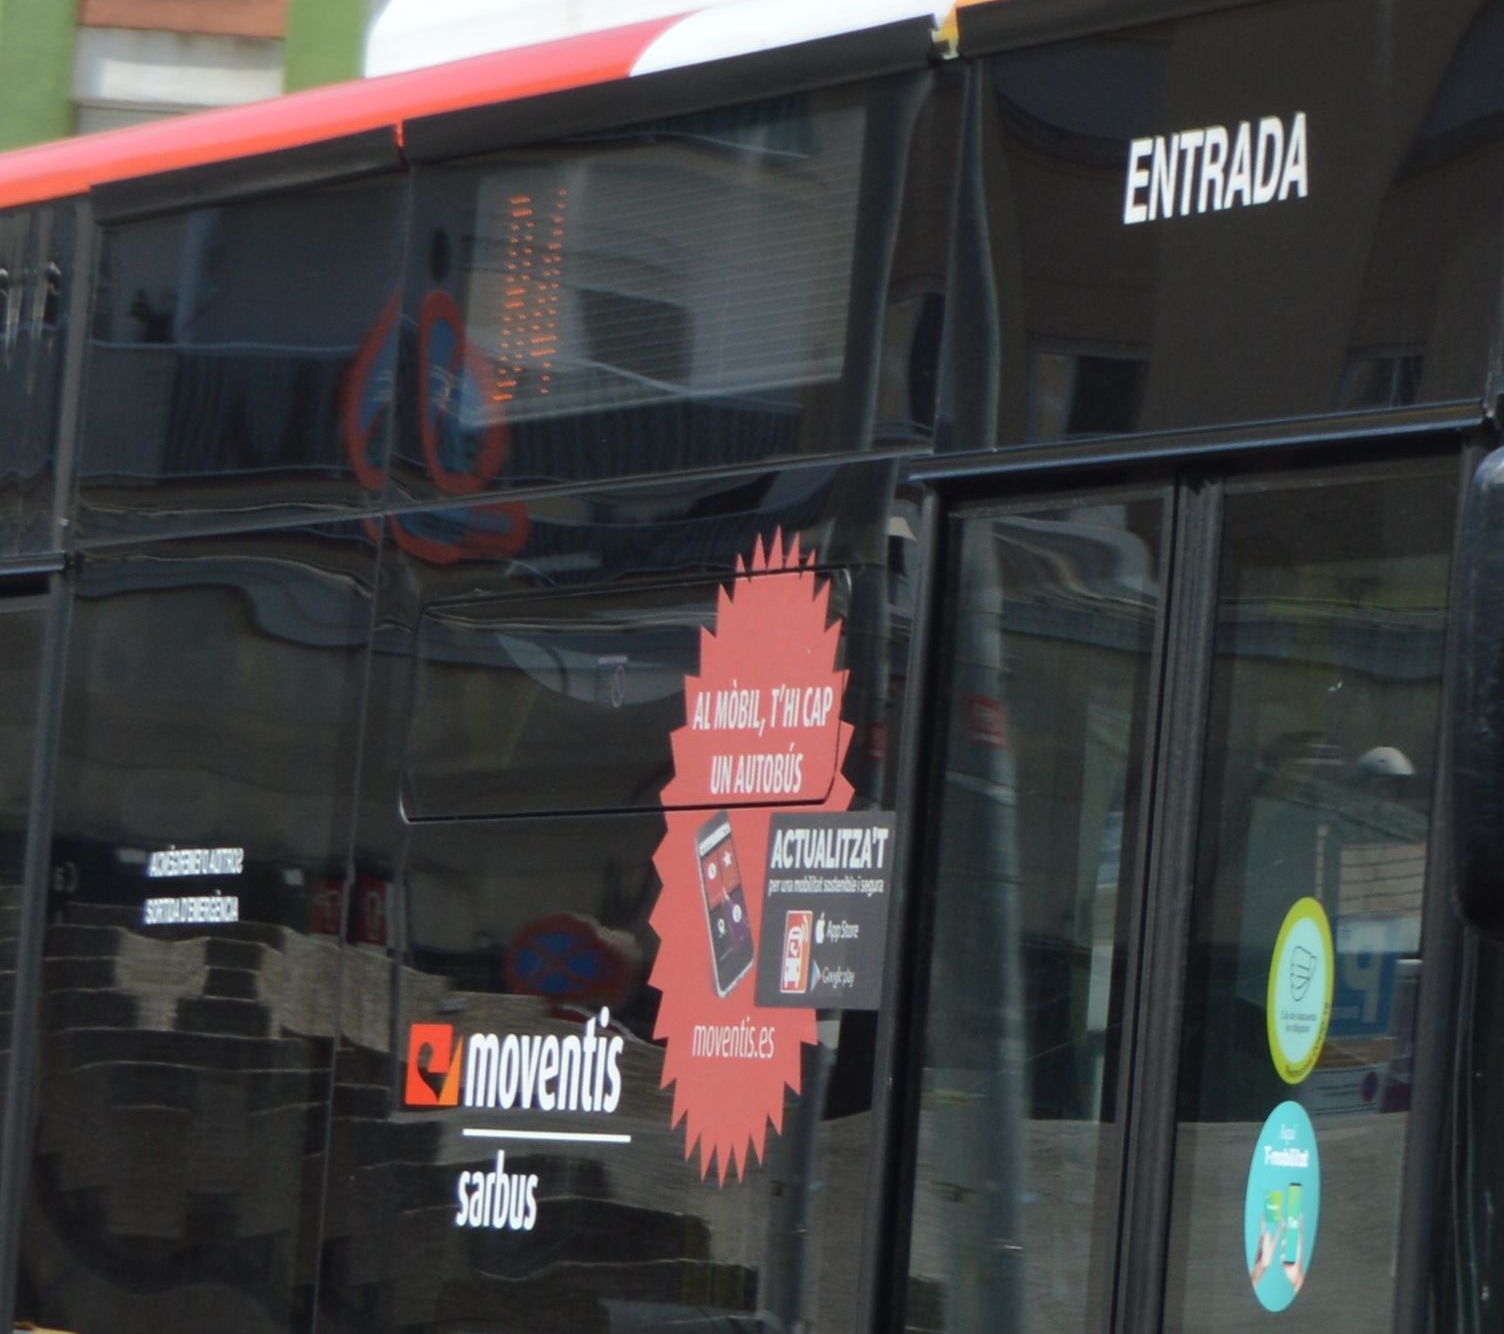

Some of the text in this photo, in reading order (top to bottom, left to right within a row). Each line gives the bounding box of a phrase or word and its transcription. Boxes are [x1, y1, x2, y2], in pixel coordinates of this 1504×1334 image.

[1123, 110, 1309, 225] ENTRADA
[692, 691, 711, 730] AL
[714, 679, 766, 737] MÒBIL,
[803, 686, 834, 727] CAP
[710, 742, 804, 795] UN AUTOBÚS
[770, 826, 889, 869] ACTUALITZA'T
[464, 1006, 624, 1113] moventis
[692, 1017, 775, 1059] moventis.es
[456, 1150, 538, 1230] sarbus
